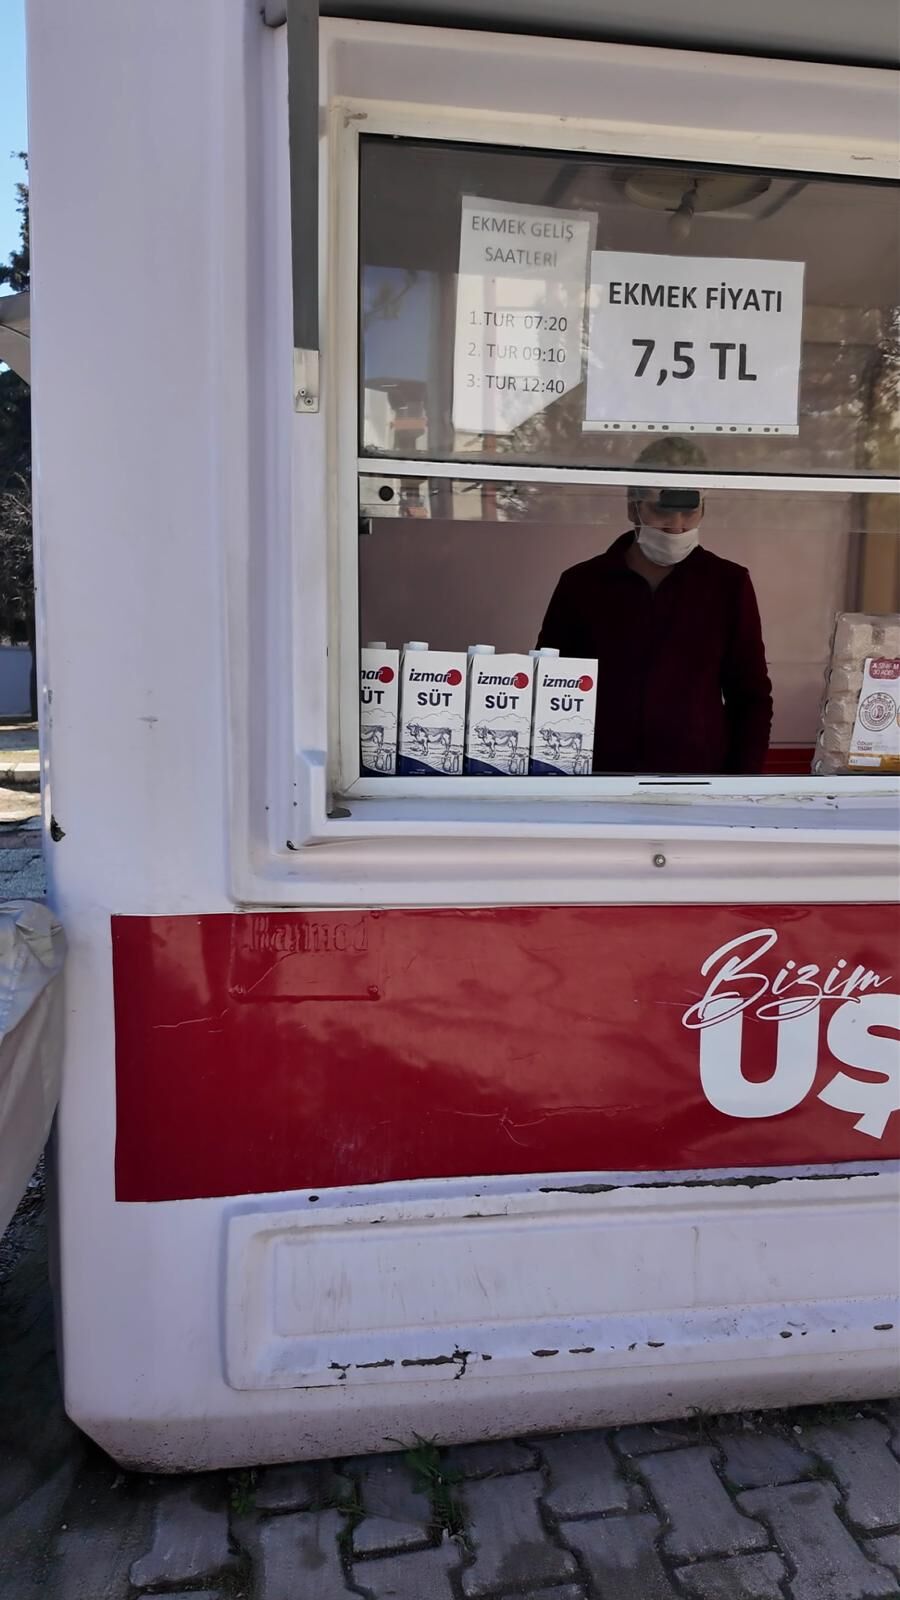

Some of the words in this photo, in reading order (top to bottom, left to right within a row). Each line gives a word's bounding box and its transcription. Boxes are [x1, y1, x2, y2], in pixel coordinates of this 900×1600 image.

[472, 215, 526, 236] EKMEK
[530, 220, 575, 243] GELİŞ
[484, 246, 558, 268] SAATLERİ
[608, 281, 698, 310] EKMEK
[705, 281, 783, 313] FİYATI
[523, 315, 568, 332] 07:20
[486, 343, 519, 360] TUR
[522, 347, 566, 364] 09:10
[631, 338, 696, 386] 7,5
[709, 342, 757, 382] TL
[485, 374, 517, 391] TUR
[522, 377, 565, 394] 12:40
[409, 669, 451, 683] izmar
[477, 672, 518, 686] izmar
[542, 675, 582, 689] izmar
[361, 686, 385, 704] ÜT
[417, 689, 453, 707] SÜT
[485, 692, 520, 710] SÜT
[550, 694, 584, 712] SÜT
[682, 928, 892, 1029] Bizim
